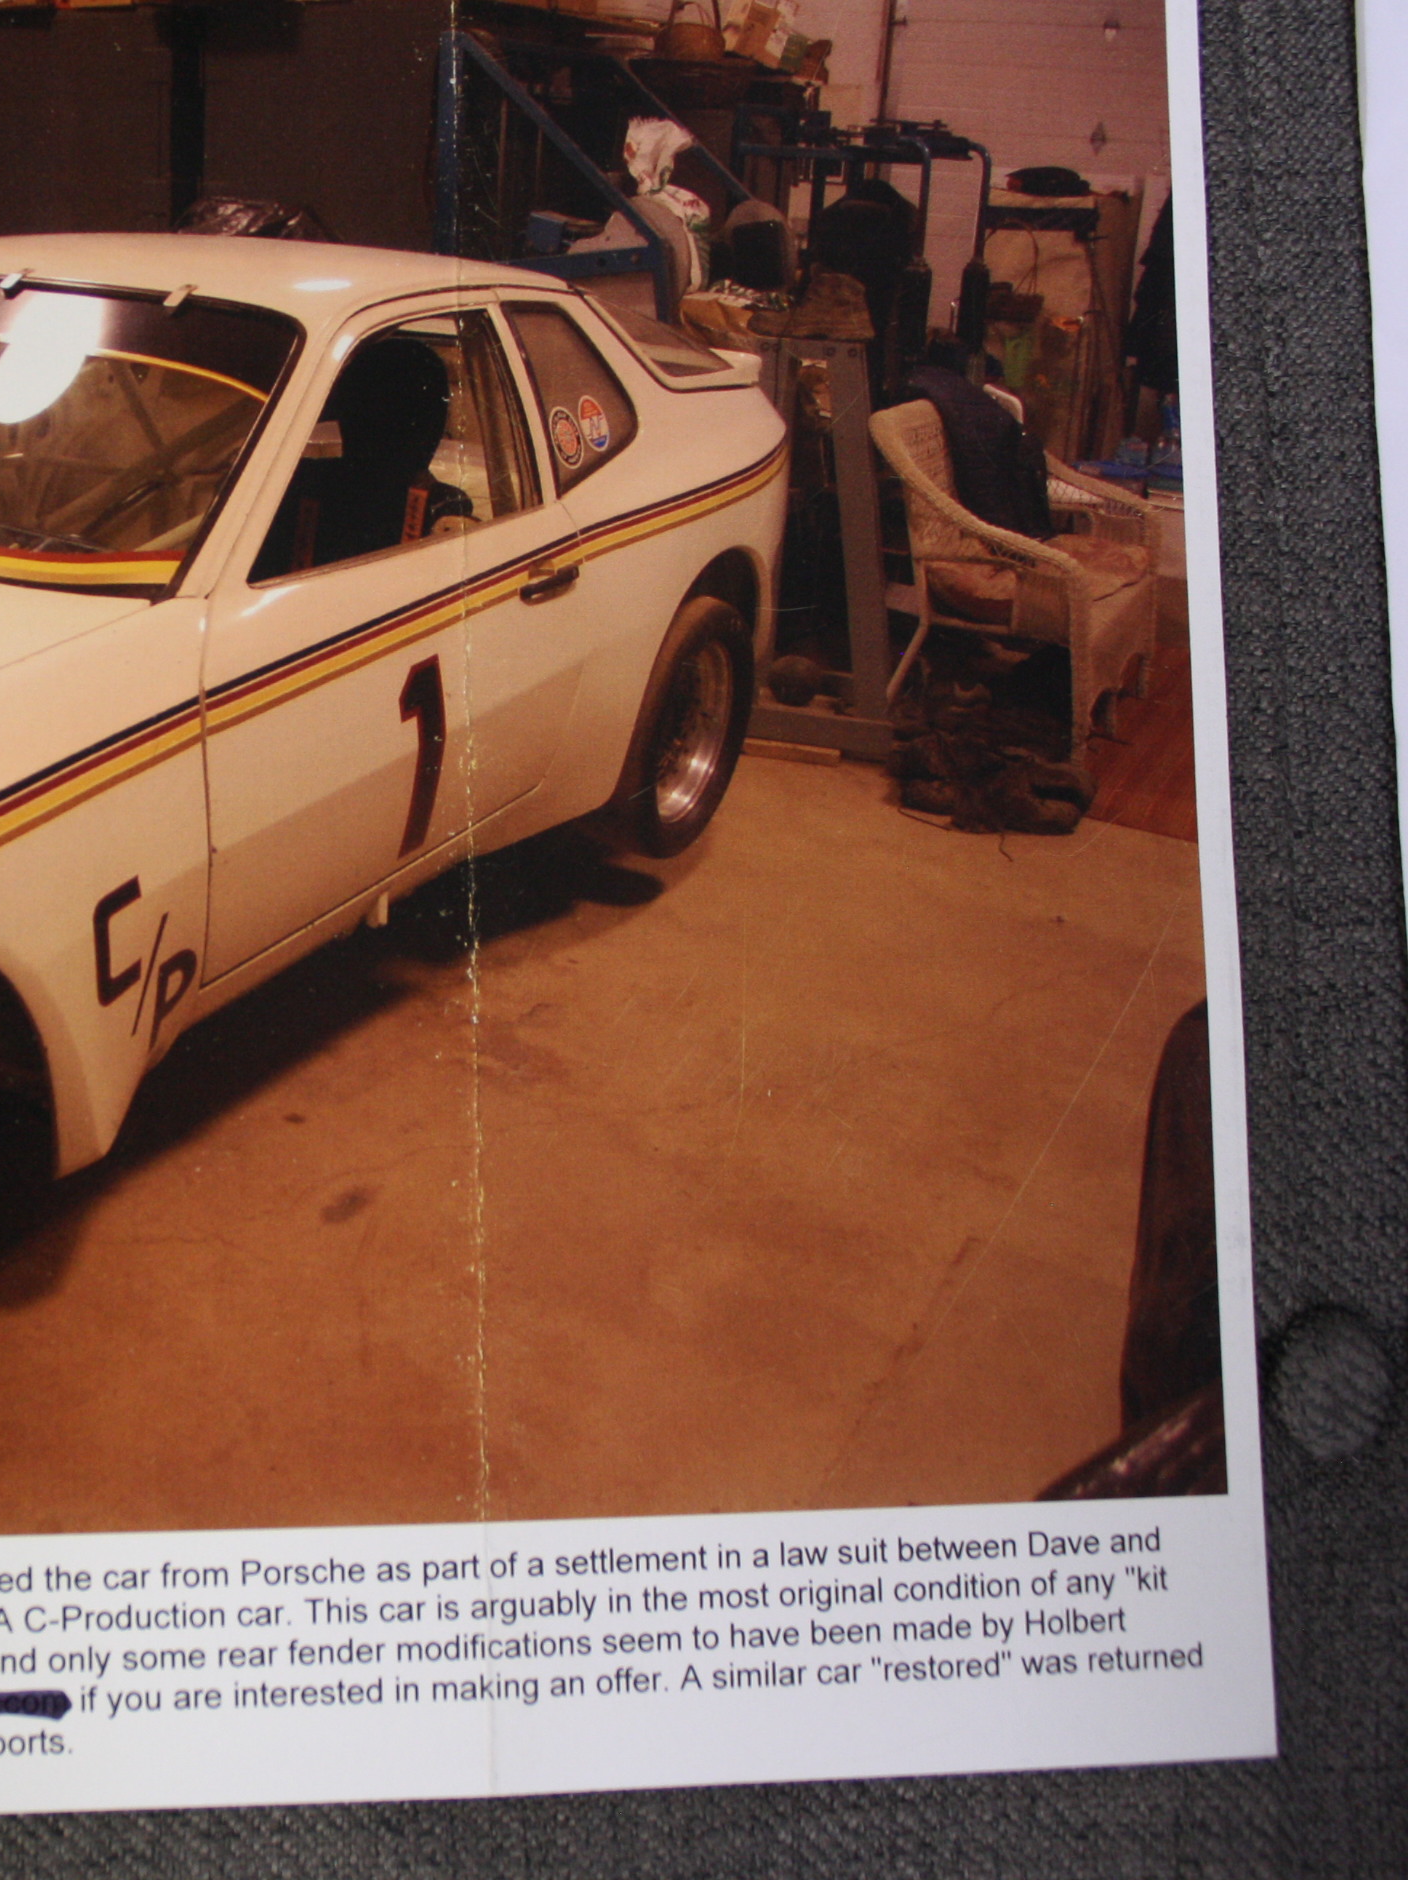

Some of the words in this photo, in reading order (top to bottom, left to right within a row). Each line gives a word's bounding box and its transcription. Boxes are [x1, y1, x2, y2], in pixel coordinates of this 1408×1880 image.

[398, 653, 447, 860] 1
[93, 873, 198, 1051] C/P
[43, 1564, 93, 1593] the
[102, 1567, 151, 1591] car
[159, 1560, 229, 1589] from
[240, 1555, 366, 1587] Porsche
[376, 1560, 412, 1584] as
[422, 1552, 481, 1588] part
[489, 1550, 519, 1579] of
[527, 1555, 545, 1578] a
[554, 1544, 708, 1577] settlement
[717, 1542, 742, 1570] in
[752, 1546, 770, 1569] a
[779, 1539, 829, 1568] law
[837, 1536, 889, 1566] suit
[897, 1534, 1018, 1563] between
[1027, 1529, 1101, 1558] Dave
[1109, 1524, 1161, 1555] and
[23, 1600, 226, 1634] C-Production
[236, 1604, 292, 1628] car.
[303, 1595, 369, 1625] This
[378, 1600, 427, 1623] car
[436, 1592, 460, 1622] is
[470, 1587, 598, 1627] arguably
[608, 1586, 632, 1614] in
[641, 1584, 688, 1613] the
[698, 1581, 770, 1610] most
[778, 1575, 884, 1614] original
[893, 1571, 1021, 1603] condition
[1030, 1568, 1059, 1597] of
[1066, 1572, 1116, 1600] any
[1124, 1563, 1169, 1592] "kit
[47, 1643, 112, 1679] only
[122, 1647, 206, 1672] some
[217, 1645, 279, 1669] rear
[287, 1636, 387, 1667] fender
[396, 1629, 593, 1663] modifications
[601, 1630, 683, 1655] seem
[691, 1624, 720, 1651] to
[729, 1620, 800, 1649] have
[810, 1617, 882, 1646] been
[892, 1612, 972, 1642] made
[981, 1610, 1015, 1645] by
[1024, 1605, 1127, 1636] Holbert
[80, 1683, 99, 1713] if
[106, 1689, 162, 1720] you
[173, 1687, 223, 1711] are
[233, 1675, 384, 1709] interested
[394, 1674, 420, 1703] in
[431, 1671, 540, 1706] making
[549, 1674, 585, 1698] an
[595, 1665, 669, 1696] offer.
[679, 1662, 703, 1691] A
[711, 1659, 808, 1690] similar
[816, 1662, 863, 1686] car
[870, 1649, 1012, 1683] "restored"
[1020, 1652, 1079, 1676] was
[1087, 1640, 1204, 1673] returned
